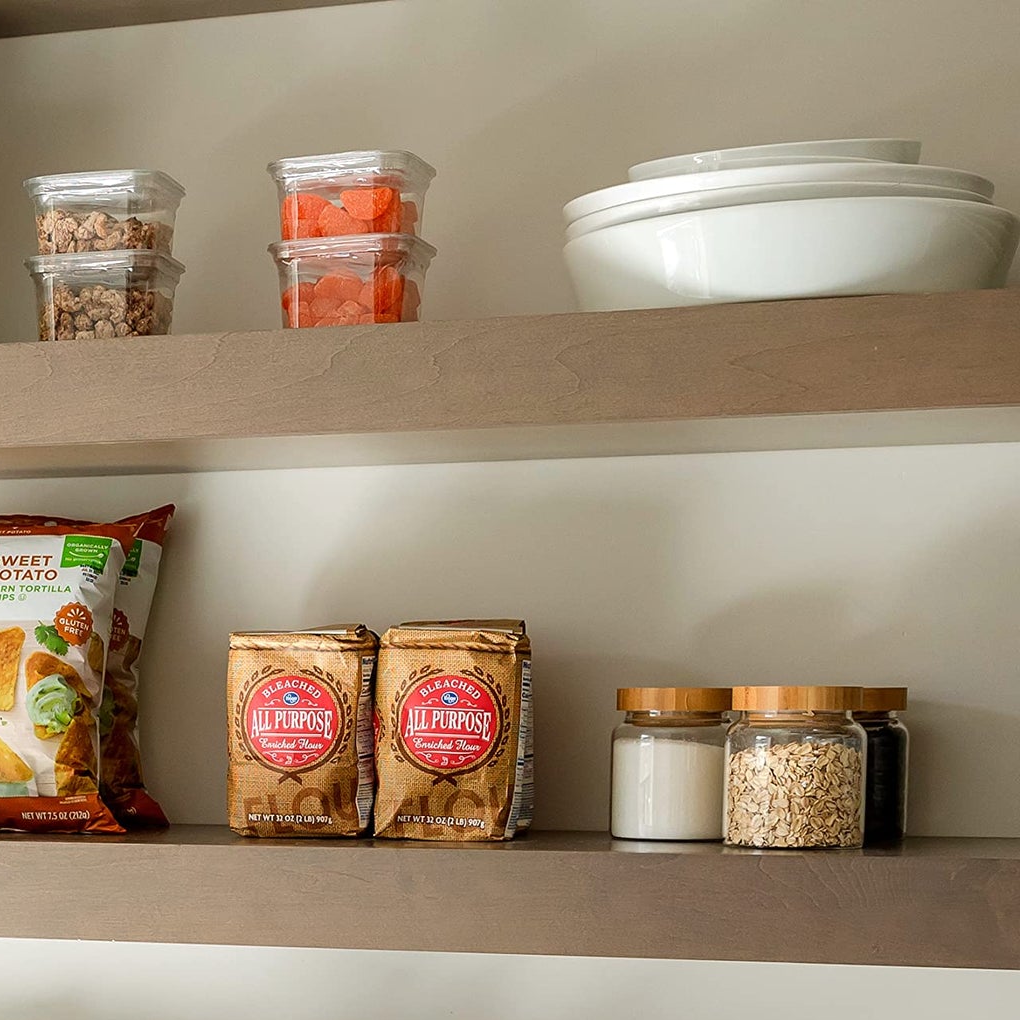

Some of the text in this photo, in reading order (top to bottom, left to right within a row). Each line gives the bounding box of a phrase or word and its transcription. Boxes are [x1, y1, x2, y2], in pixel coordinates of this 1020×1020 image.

[66, 542, 109, 550] ORGANICALLY
[19, 585, 72, 593] TORTILLA
[59, 617, 90, 631] GLUTEN
[64, 626, 84, 637] FREE
[262, 679, 321, 699] BLEACHED
[420, 679, 481, 700] BLEACHED
[251, 709, 333, 740] ALL PURPOSE
[404, 708, 492, 742] ALL PURPOSE
[259, 737, 324, 749] Enriched Flour
[412, 737, 481, 751] Enriched Flour
[21, 810, 91, 821] NET WT 7.5 OZ (212g)
[248, 813, 333, 824] NET WT 32 OZ (2 LB) 907g
[412, 815, 425, 823] WT
[426, 815, 434, 823] 32
[435, 816, 446, 824] OZ
[447, 816, 455, 827] (2
[455, 817, 467, 828] LB)
[468, 818, 485, 829] 907g
